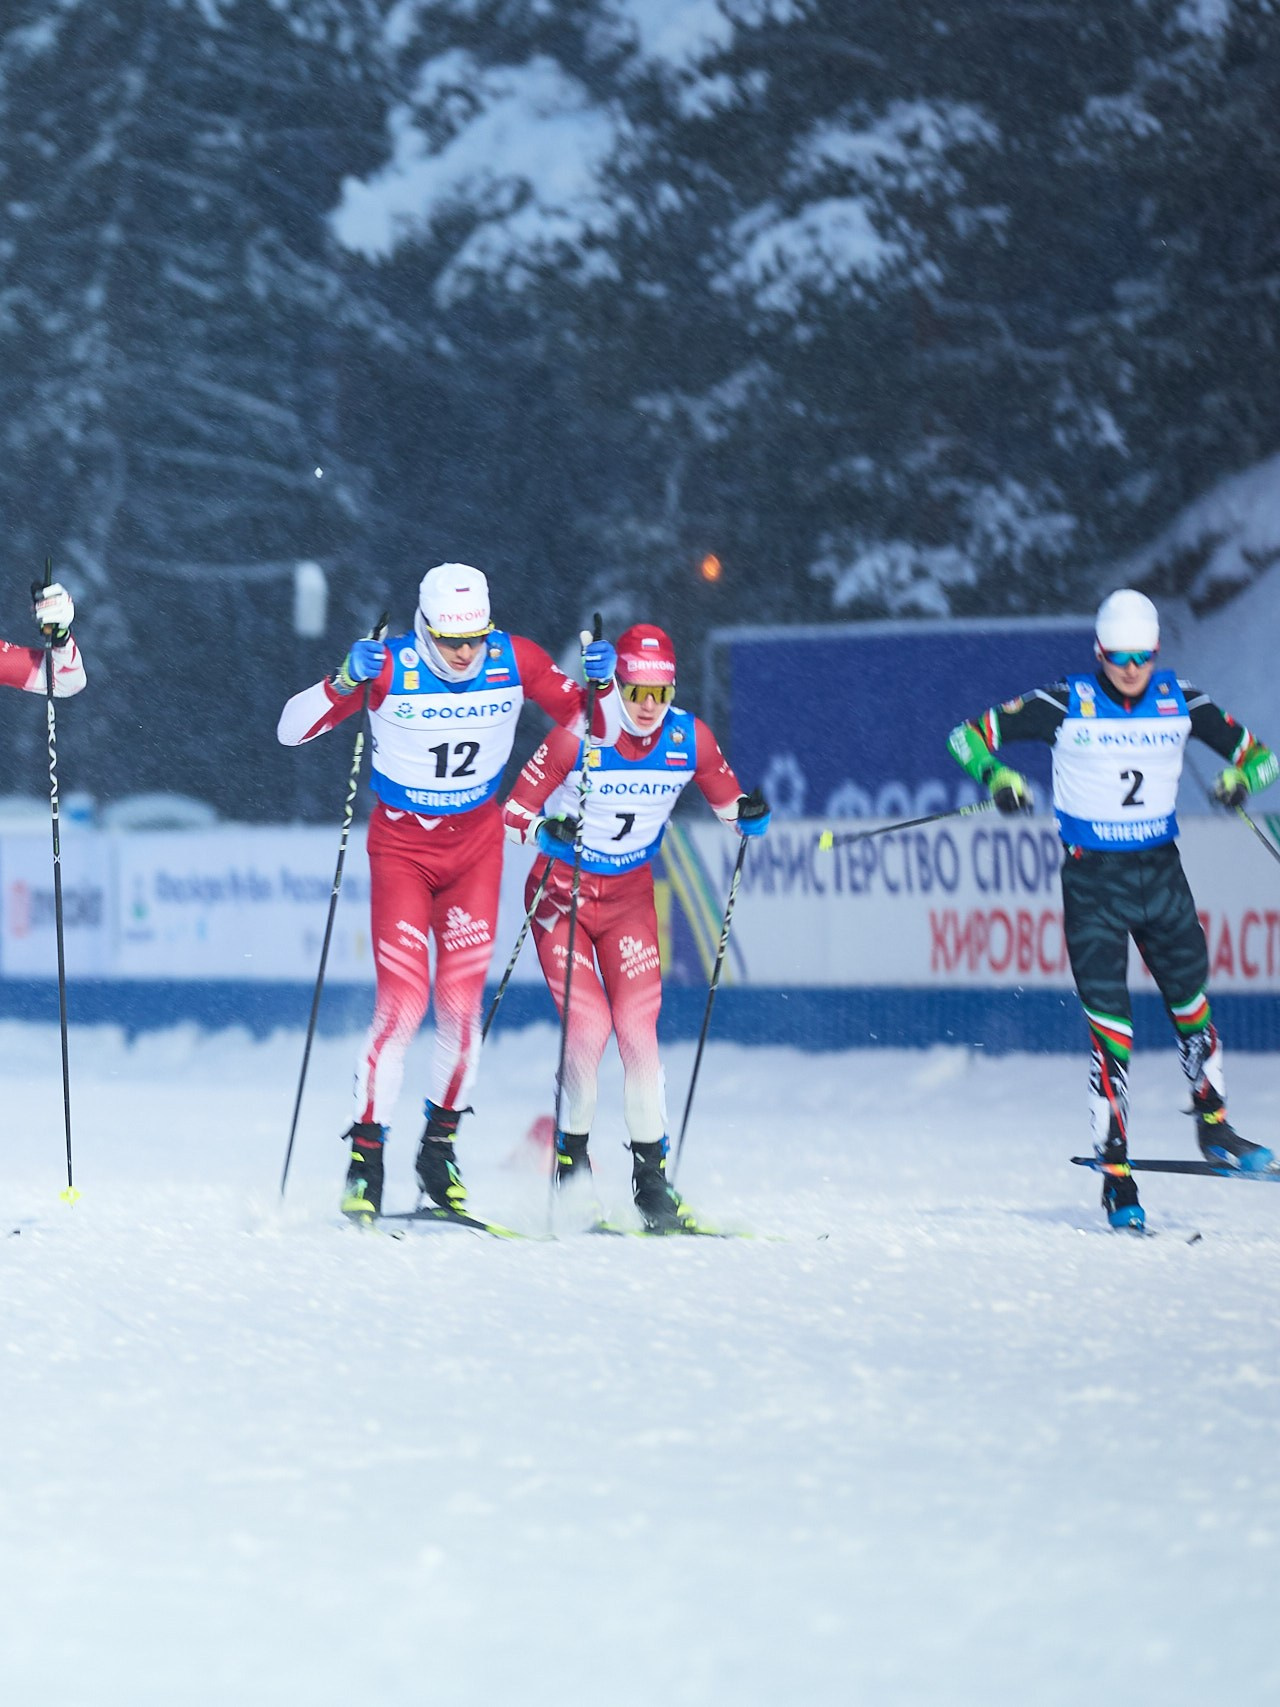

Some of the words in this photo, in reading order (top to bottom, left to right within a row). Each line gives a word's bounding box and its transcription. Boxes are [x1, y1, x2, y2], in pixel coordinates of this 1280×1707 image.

[420, 700, 514, 720] ФОСАГРО
[1097, 731, 1182, 747] ФОСАГРО
[428, 740, 481, 778] 12
[599, 782, 683, 797] ФОСАГРО
[1120, 768, 1145, 807] 2
[611, 812, 636, 841] 7
[722, 830, 962, 896] МИНИСТЕРСТВО
[973, 828, 1063, 894] СПОР
[928, 908, 1067, 974] КИРОВС
